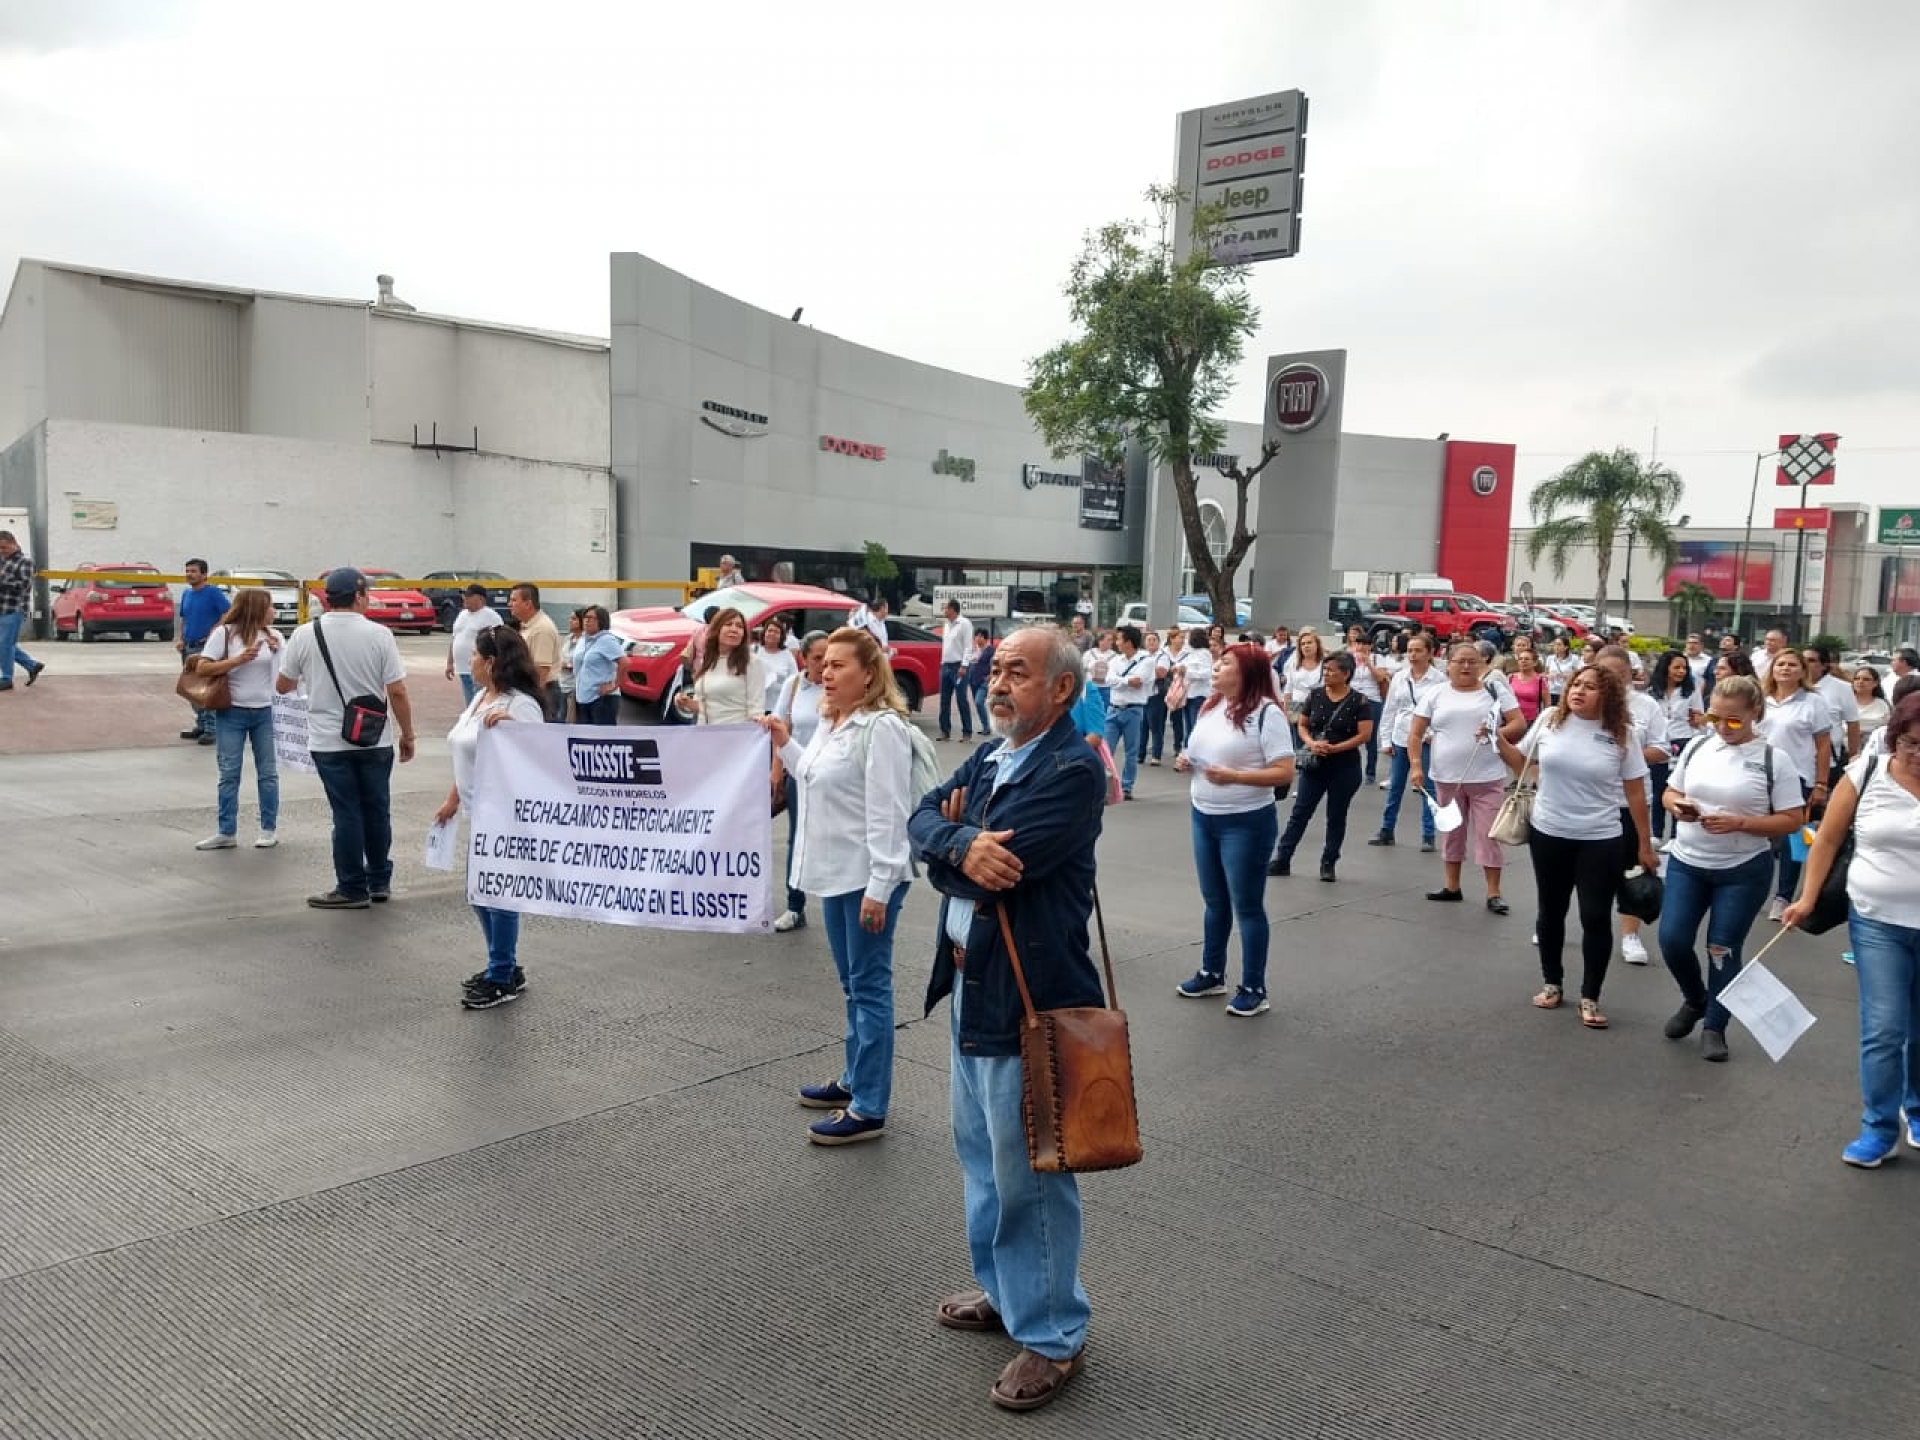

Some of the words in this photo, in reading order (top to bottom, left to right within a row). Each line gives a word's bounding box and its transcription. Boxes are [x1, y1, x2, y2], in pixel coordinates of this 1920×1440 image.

[1206, 146, 1286, 170] DODGE
[1214, 186, 1270, 209] Jeep
[1280, 380, 1317, 413] FIAT
[819, 434, 887, 461] DODGE
[624, 788, 667, 799] MORELOS
[515, 799, 610, 829] RECHAZAMOS
[611, 801, 715, 835] ENÉRGICAMENTE
[474, 833, 489, 857] EL
[494, 835, 538, 862] CIERRE
[539, 839, 562, 864] DE
[562, 841, 630, 871] CENTROS
[630, 847, 647, 872] DE
[650, 849, 706, 876] TRABAJO
[710, 851, 721, 876] Y
[726, 851, 761, 877] LOS
[478, 871, 544, 897] DESPIDOS
[545, 878, 646, 910] INJUSTIFICADOS
[649, 889, 667, 915] EN
[671, 890, 690, 916] EL
[692, 893, 748, 920] ISSSTE
